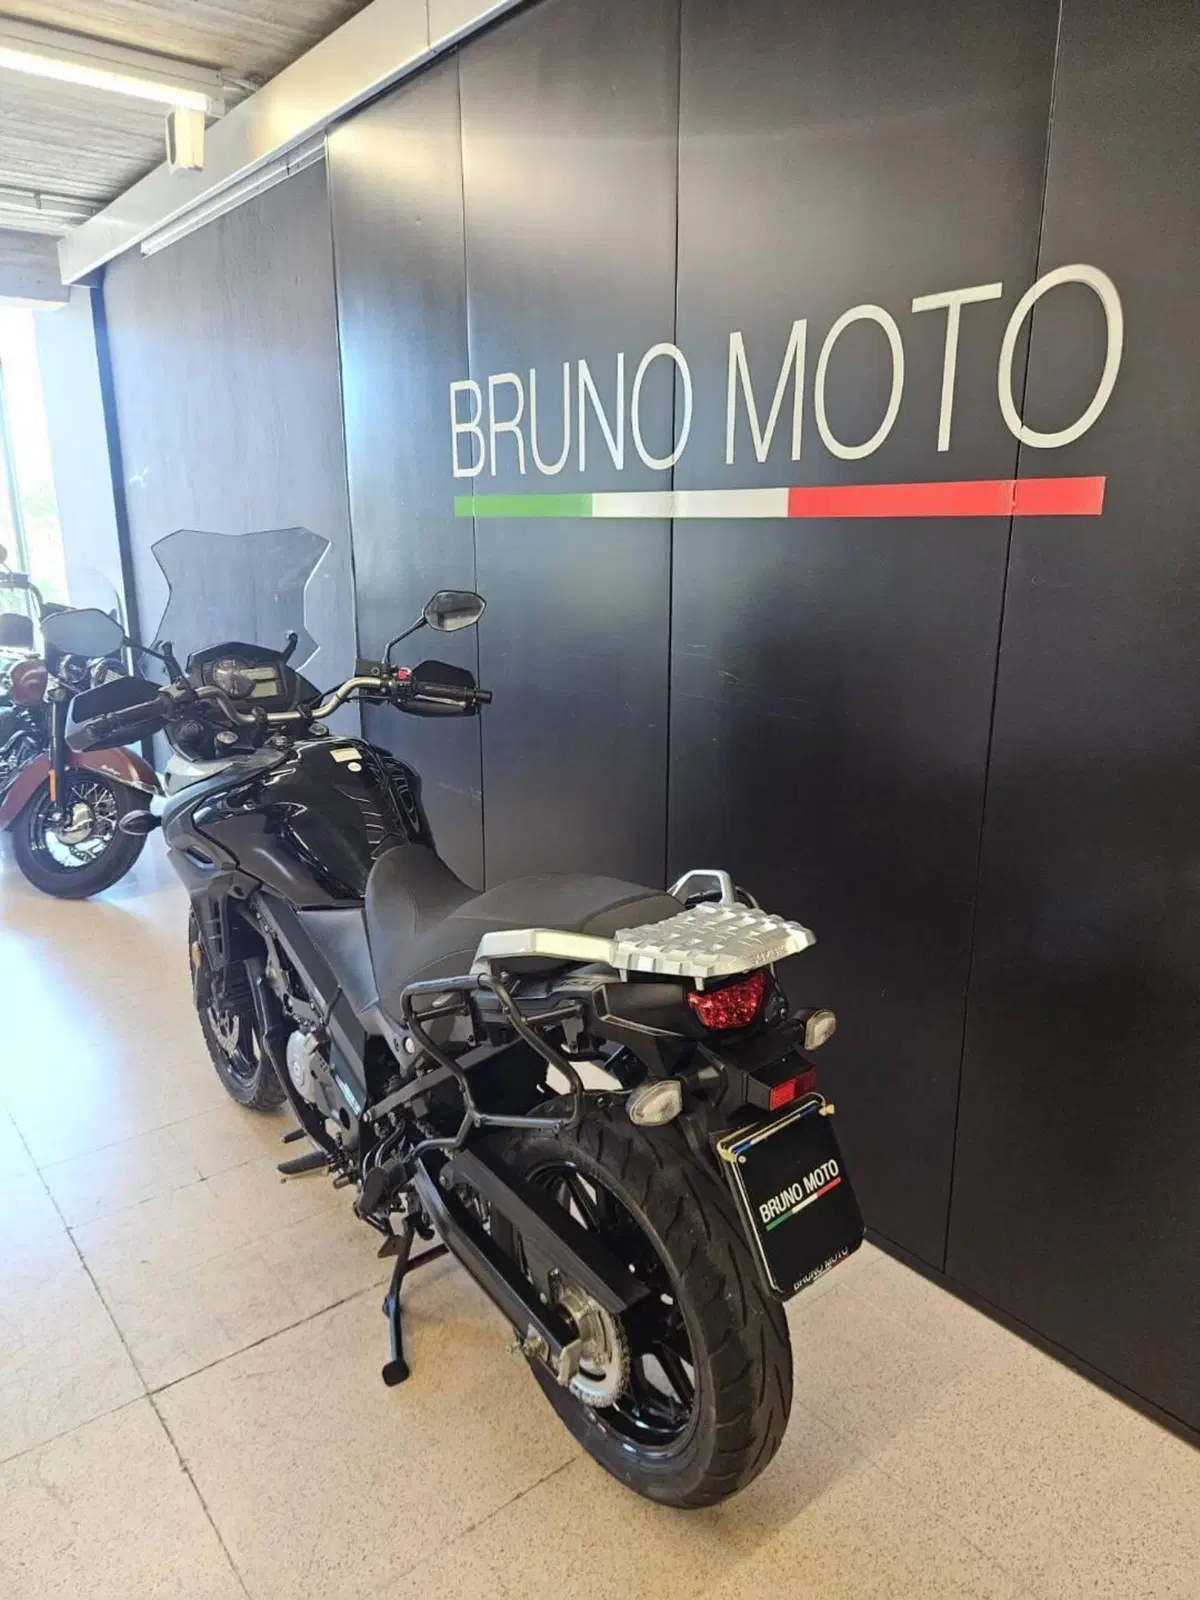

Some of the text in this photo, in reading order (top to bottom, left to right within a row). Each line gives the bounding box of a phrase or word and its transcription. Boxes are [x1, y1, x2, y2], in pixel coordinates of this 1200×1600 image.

[450, 263, 1124, 478] BRUNO MOTO
[759, 1159, 840, 1223] BRUNO MOTO
